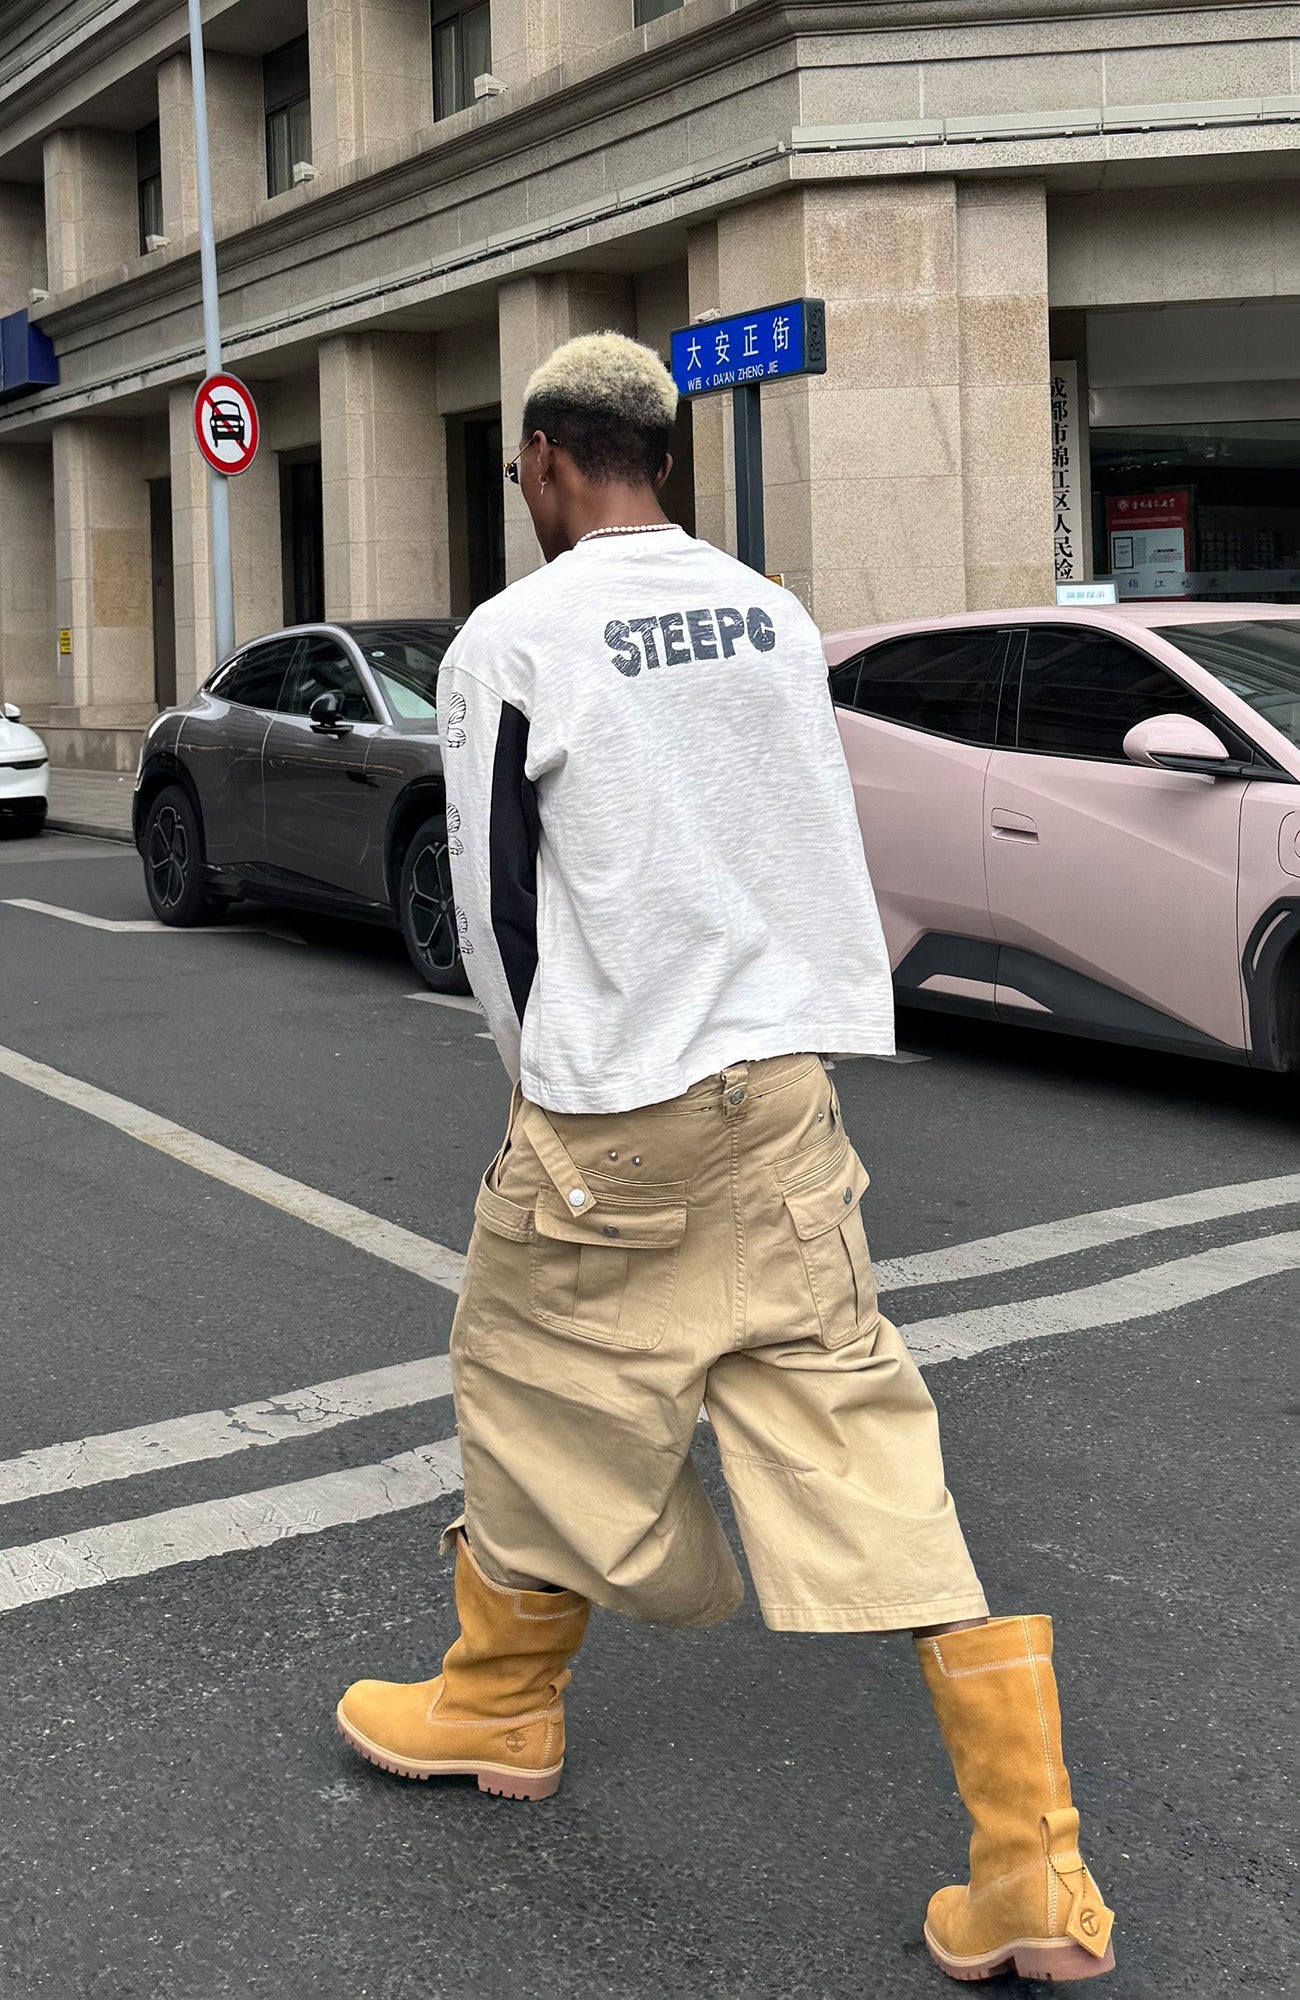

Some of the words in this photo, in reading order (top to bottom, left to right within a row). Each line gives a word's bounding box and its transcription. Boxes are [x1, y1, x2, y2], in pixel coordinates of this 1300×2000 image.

[686, 316, 790, 371] 大安正街
[713, 371, 736, 386] DA'AN
[738, 364, 764, 381] ZHENG
[767, 360, 779, 374] JIE
